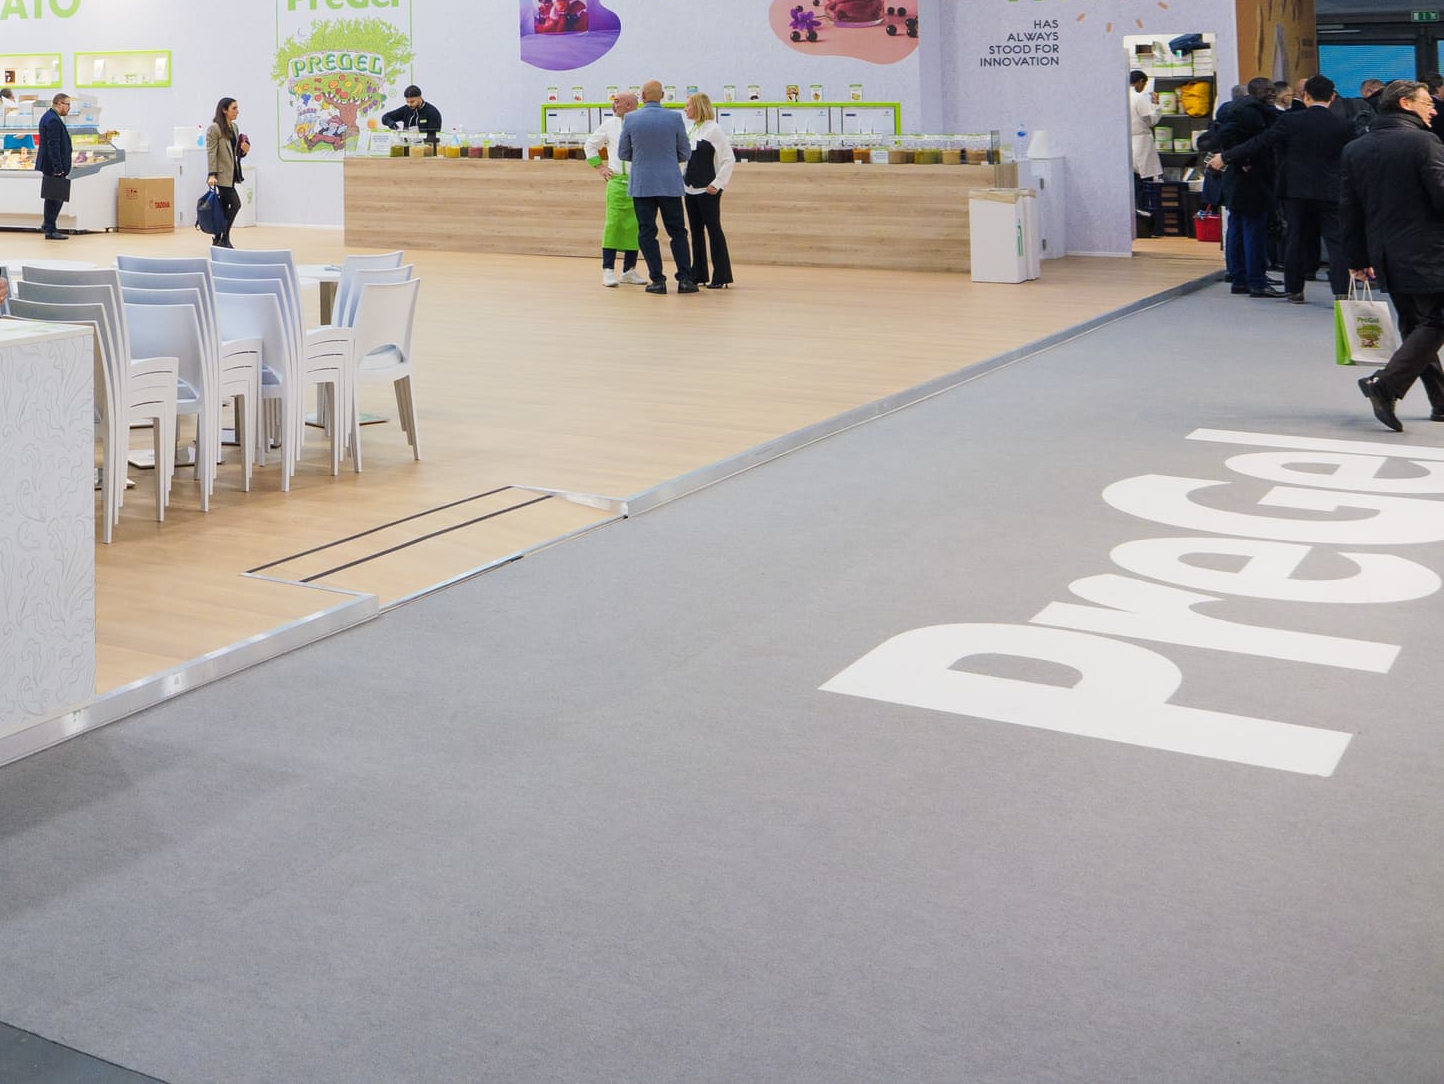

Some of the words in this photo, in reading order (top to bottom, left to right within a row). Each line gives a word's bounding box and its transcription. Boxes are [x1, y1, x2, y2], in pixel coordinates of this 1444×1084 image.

[1034, 19, 1059, 29] HAS
[1007, 32, 1060, 42] ALWAYS
[989, 45, 1032, 55] STOOD
[1035, 44, 1060, 54] FOR
[291, 53, 383, 77] PREGEL
[980, 56, 1060, 67] INNOVATION
[817, 427, 1444, 778] PreGel
